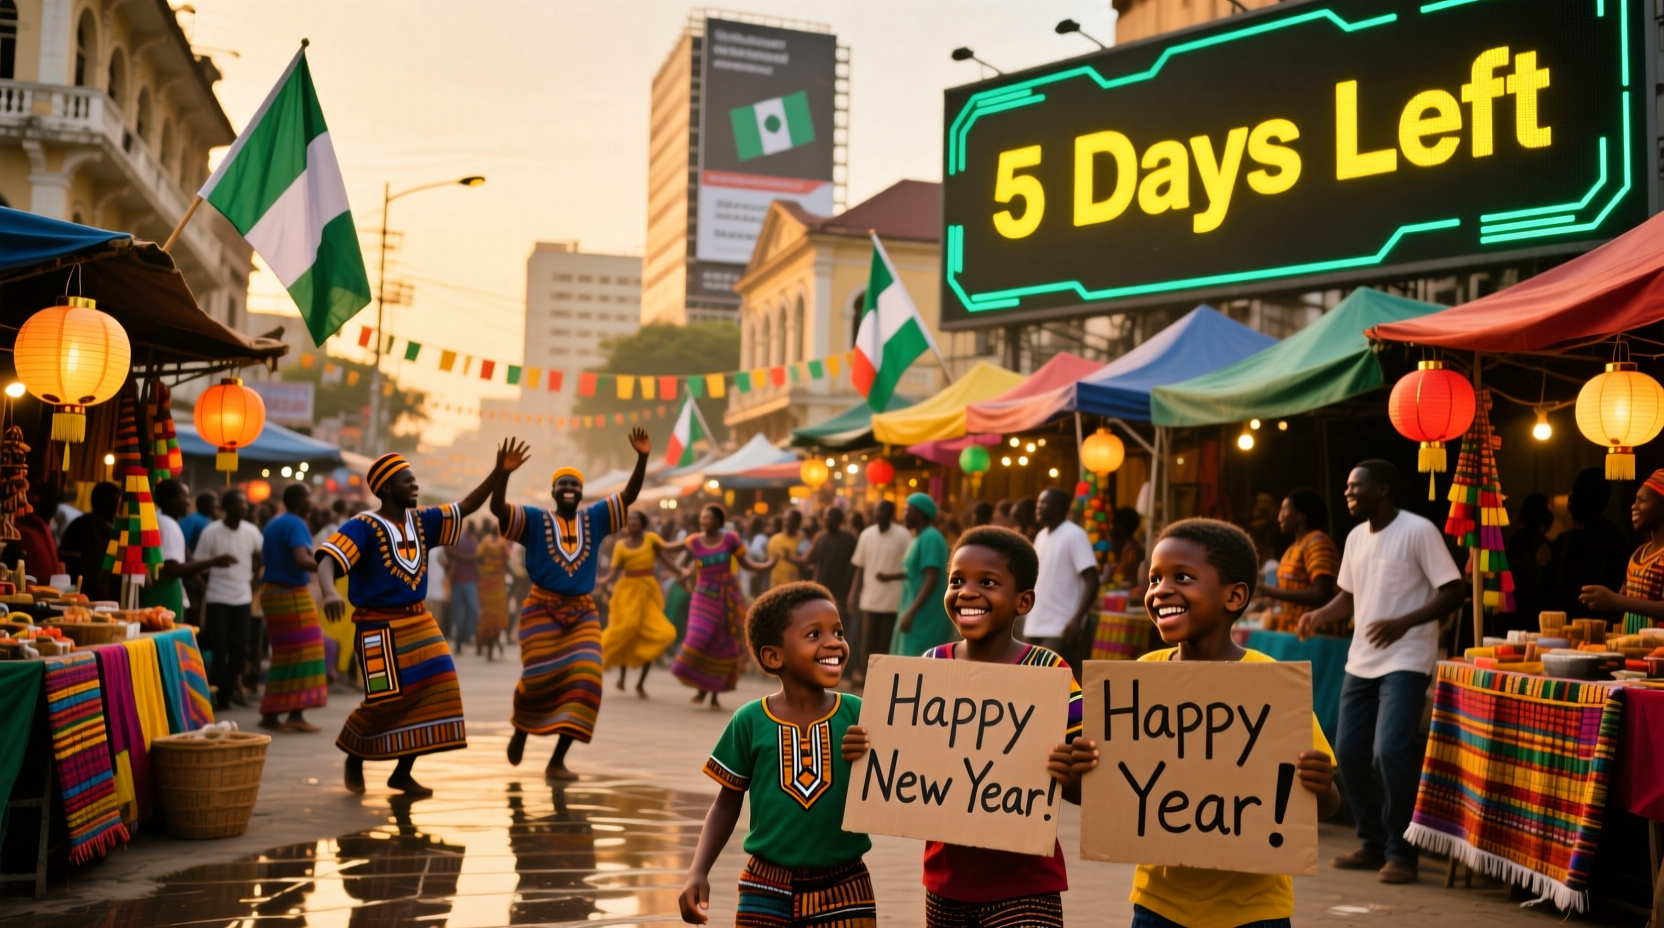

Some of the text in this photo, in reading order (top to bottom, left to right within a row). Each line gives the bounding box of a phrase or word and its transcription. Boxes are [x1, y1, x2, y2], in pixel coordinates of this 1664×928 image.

[992, 45, 1552, 240] 5 Days Left
[887, 673, 1035, 755] Happy
[1103, 679, 1271, 767] Happy
[861, 748, 1058, 822] New Year!
[1117, 761, 1297, 849] Year!
